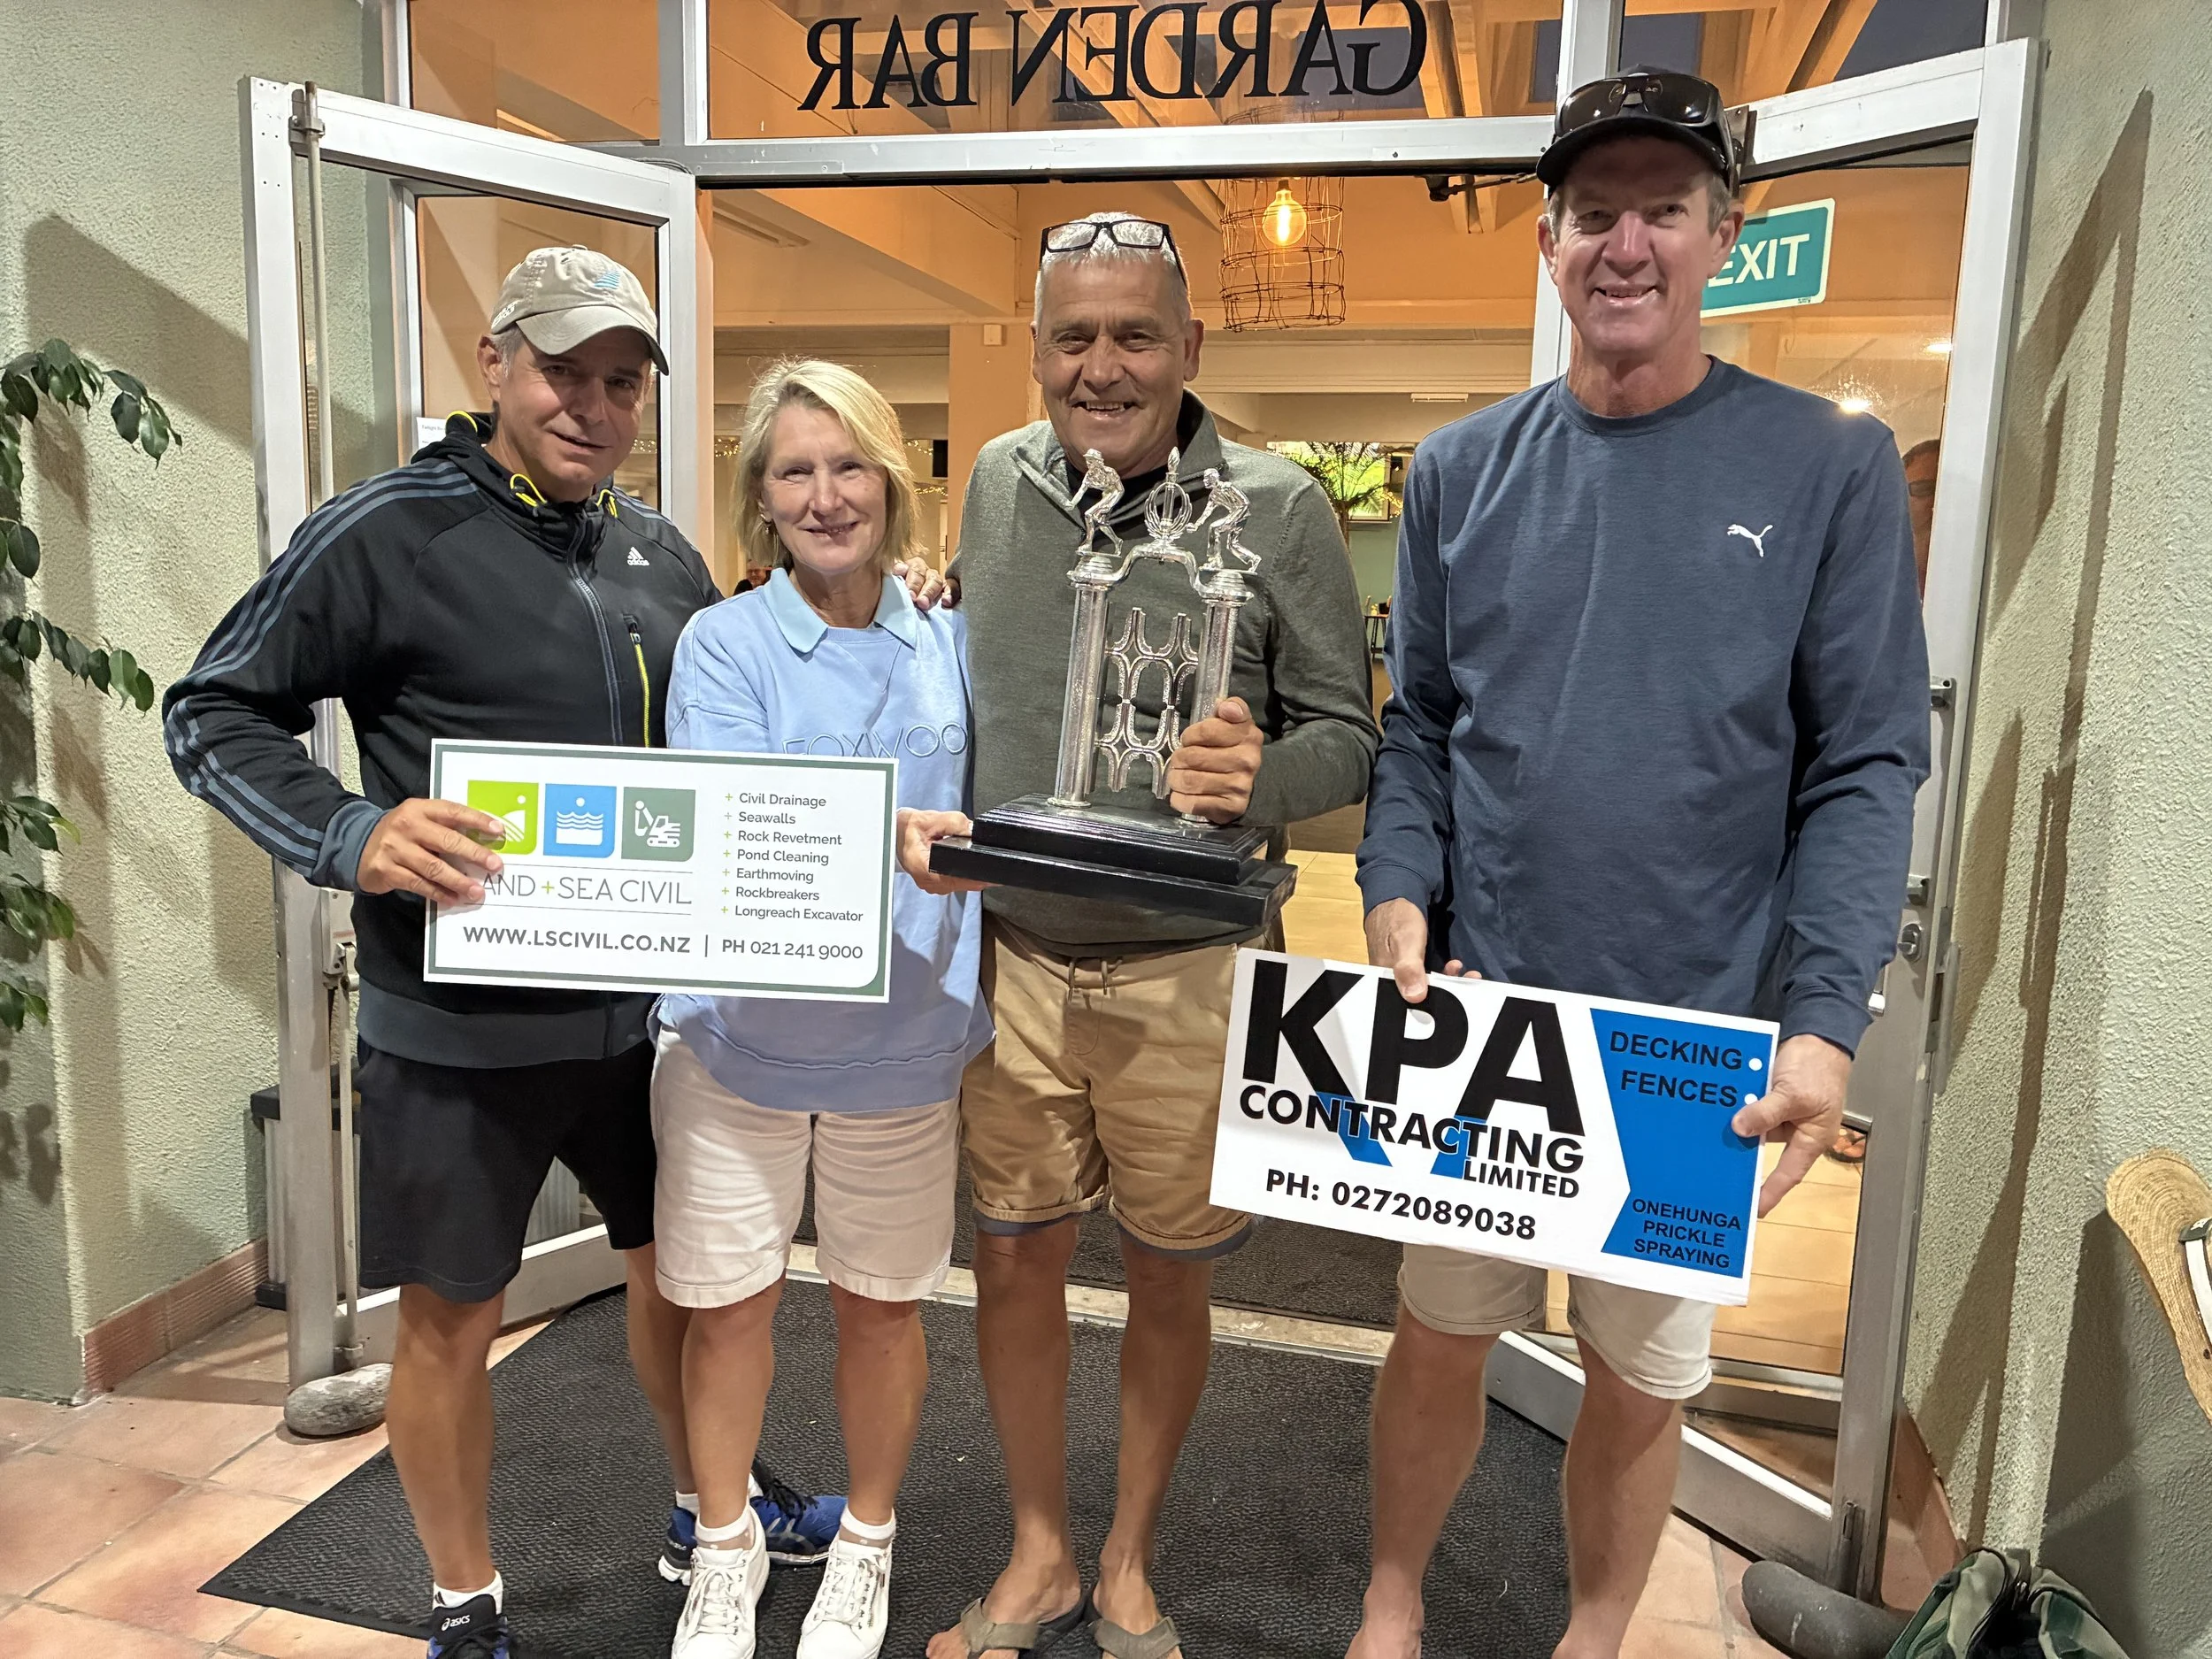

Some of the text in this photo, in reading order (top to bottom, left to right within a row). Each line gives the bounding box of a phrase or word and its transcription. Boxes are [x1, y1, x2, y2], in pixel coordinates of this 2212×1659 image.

[739, 793, 826, 809] Civil Drainage
[738, 811, 796, 825] Seawalls
[738, 830, 842, 845] Rock Revetment
[737, 849, 829, 866] Pond Cleaning
[480, 872, 536, 896] AND
[557, 876, 613, 901] SEA
[619, 879, 692, 904] CIVIL
[736, 867, 814, 884] Earthmoving
[735, 886, 820, 901] Rockbreakers
[734, 905, 864, 921] Longreach Excavator
[463, 926, 691, 953] WWW.LSCIVIL.CO.NZ
[722, 939, 864, 960] PH 021 241 9000
[1242, 958, 1586, 1137] KPA
[1610, 1031, 1742, 1070] DECKING
[1621, 1069, 1738, 1108] FENCES
[1240, 1085, 1585, 1174] CONTRACTING
[1463, 1160, 1579, 1198] LIMITED
[1266, 1168, 1536, 1240] PH: 0272089038
[1632, 1198, 1741, 1231] ONEHUNGA
[1643, 1219, 1725, 1248] PRICKLE
[1633, 1238, 1730, 1269] SPRAYING
